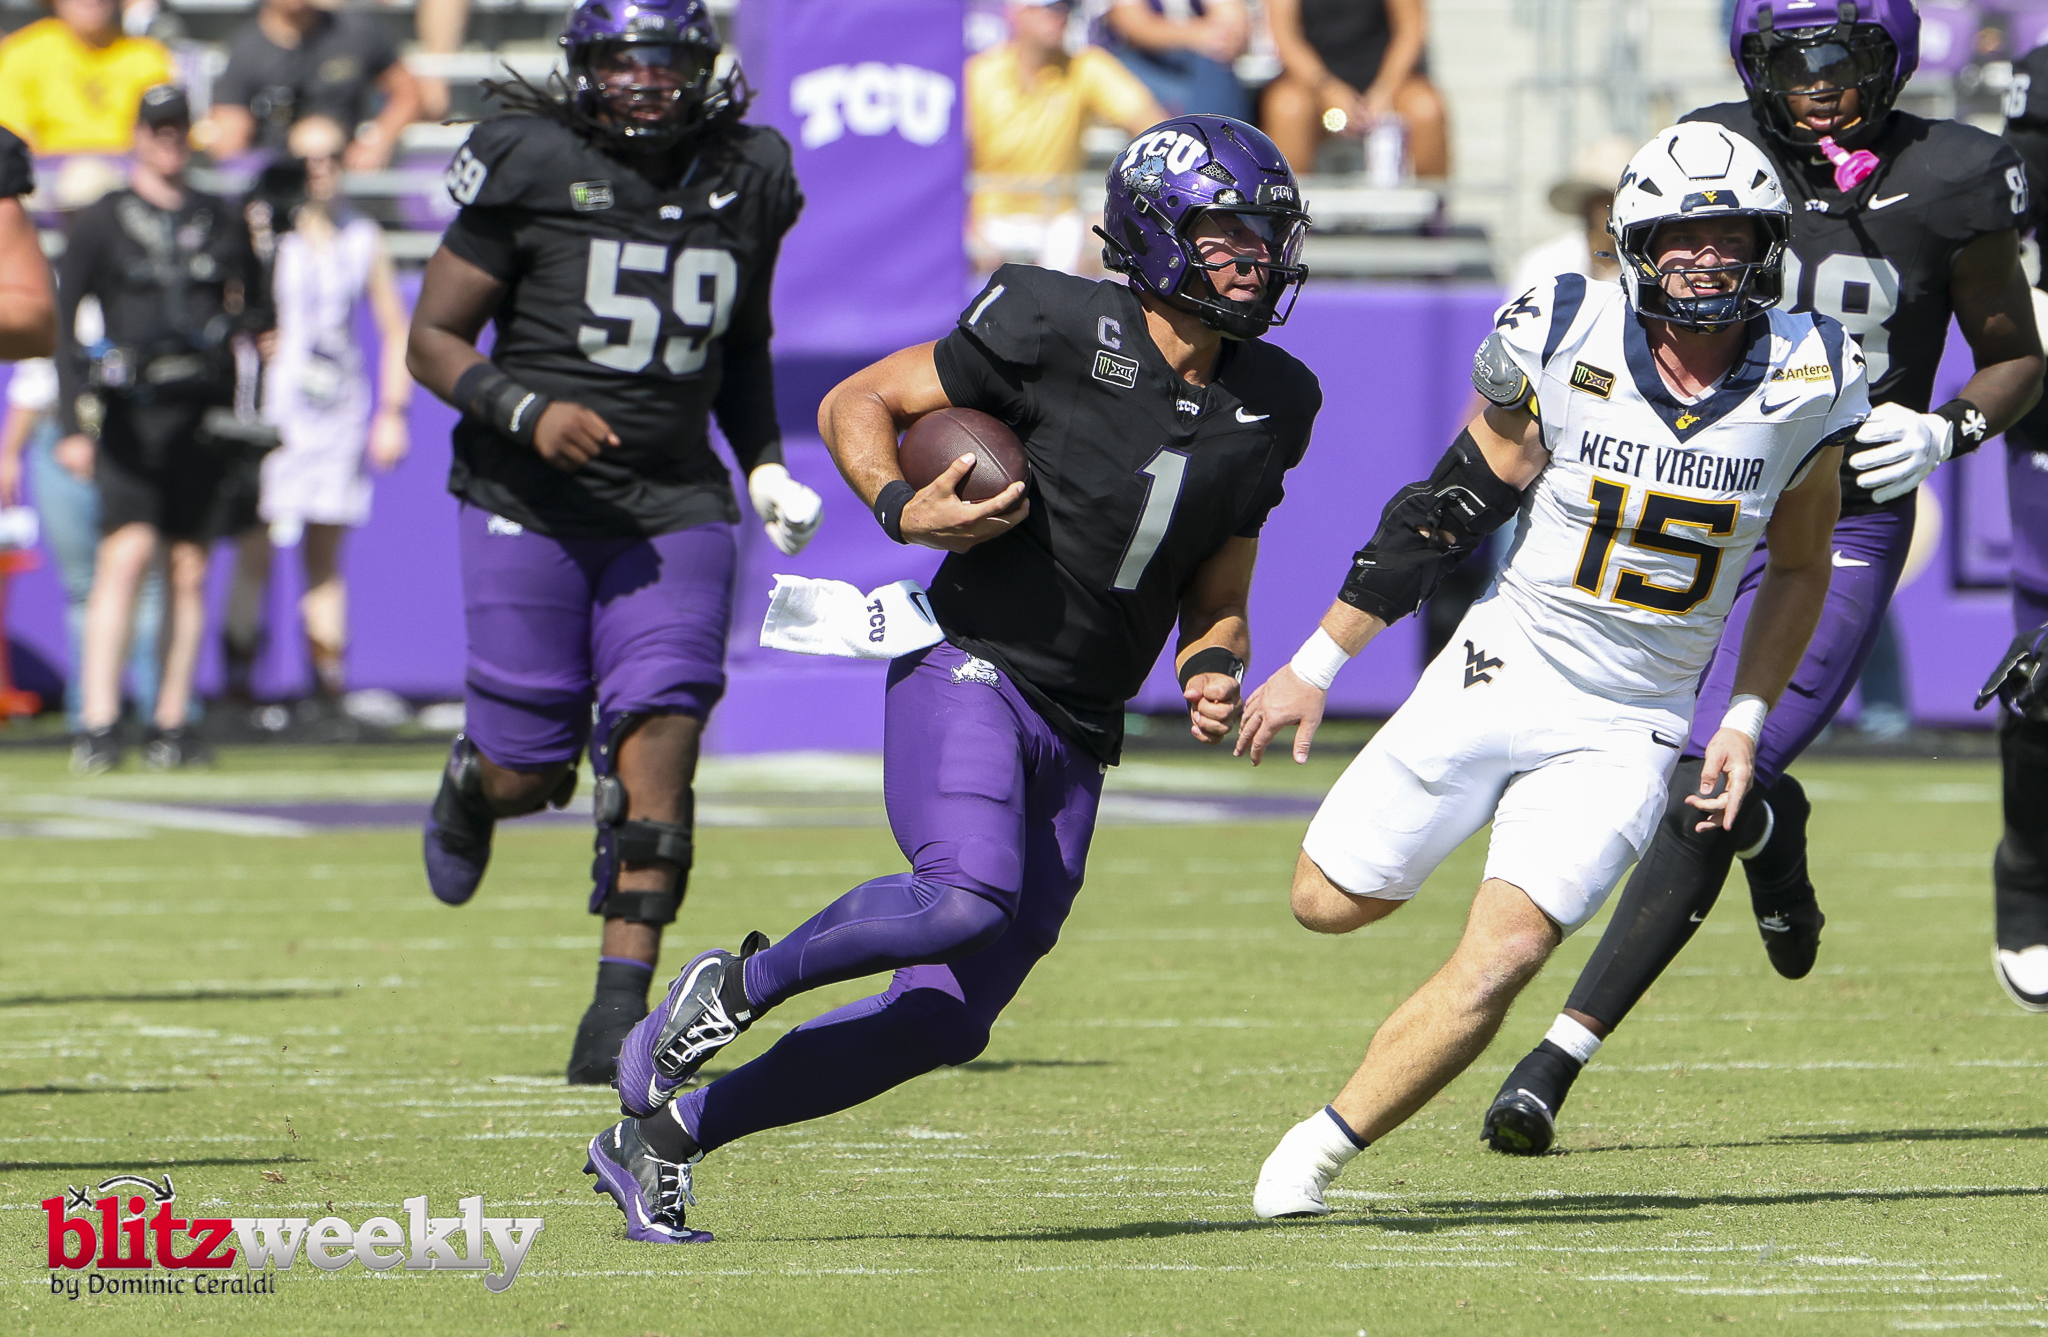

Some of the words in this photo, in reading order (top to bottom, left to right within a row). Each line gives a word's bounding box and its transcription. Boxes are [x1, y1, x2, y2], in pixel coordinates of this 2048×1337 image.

[789, 61, 956, 150] TCU
[1119, 130, 1208, 176] TCU
[577, 238, 738, 375] 59
[967, 284, 1006, 327] 1
[1097, 315, 1123, 350] C
[1786, 363, 1830, 381] Antero
[1178, 399, 1200, 416] TCU
[1579, 430, 1650, 478] WEST
[1655, 447, 1765, 491] VIRGINIA
[1108, 444, 1193, 594] 1
[1572, 474, 1741, 616] 15
[866, 598, 886, 643] TCU
